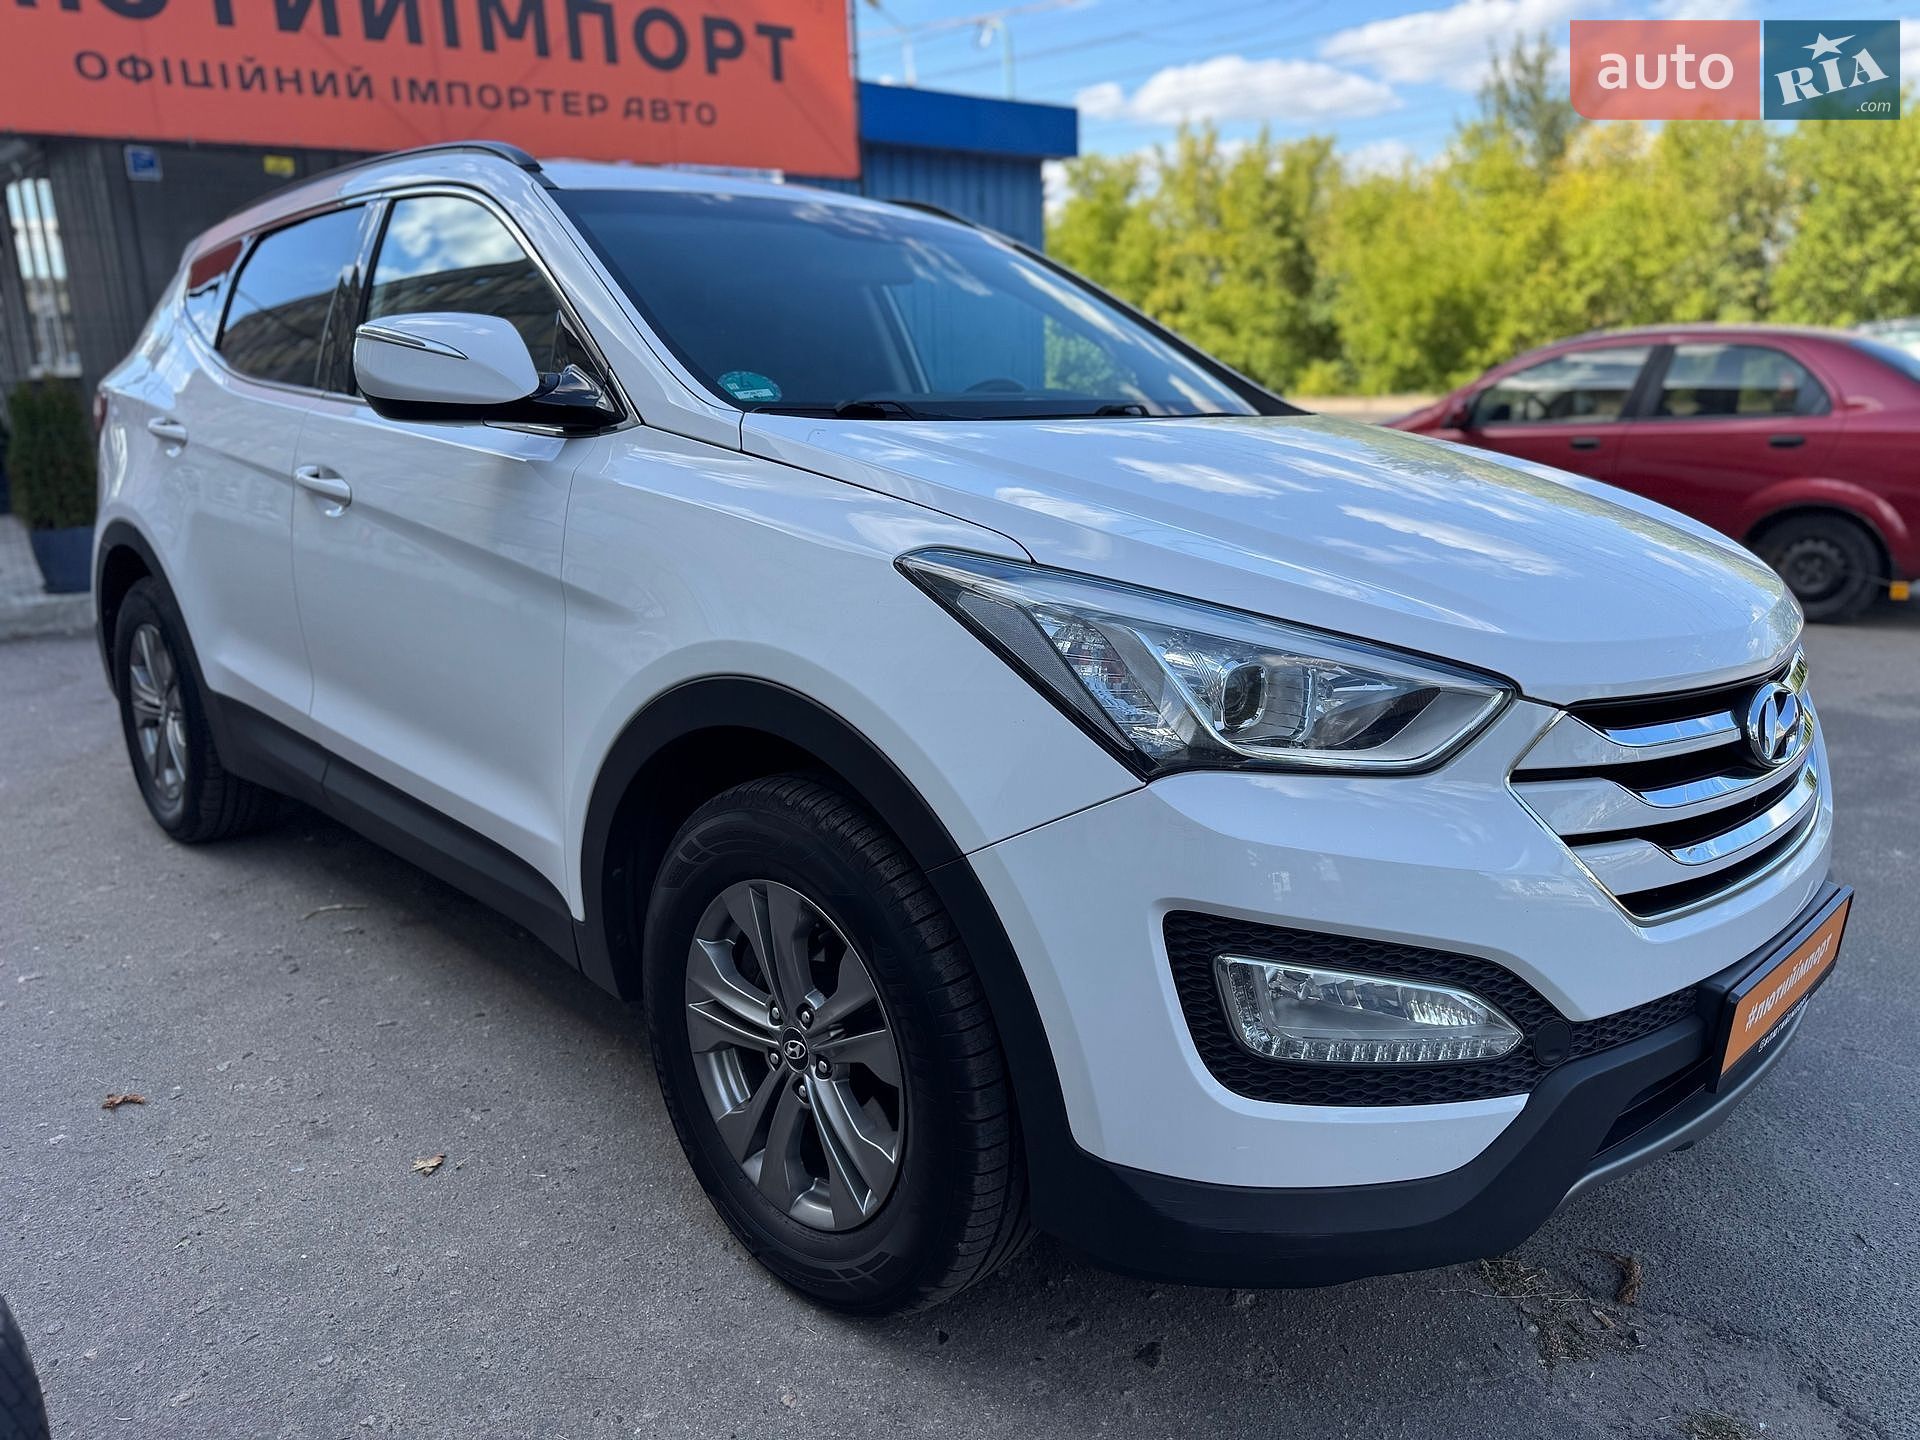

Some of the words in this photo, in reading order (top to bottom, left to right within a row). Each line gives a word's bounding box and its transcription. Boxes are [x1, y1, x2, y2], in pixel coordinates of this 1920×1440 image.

[15, 0, 795, 83] ИЙІМПОРТ
[74, 50, 374, 101] ОФІЦІЙНИЙ
[391, 76, 609, 117] ІМПОРТЕР
[622, 96, 718, 127] АВТО
